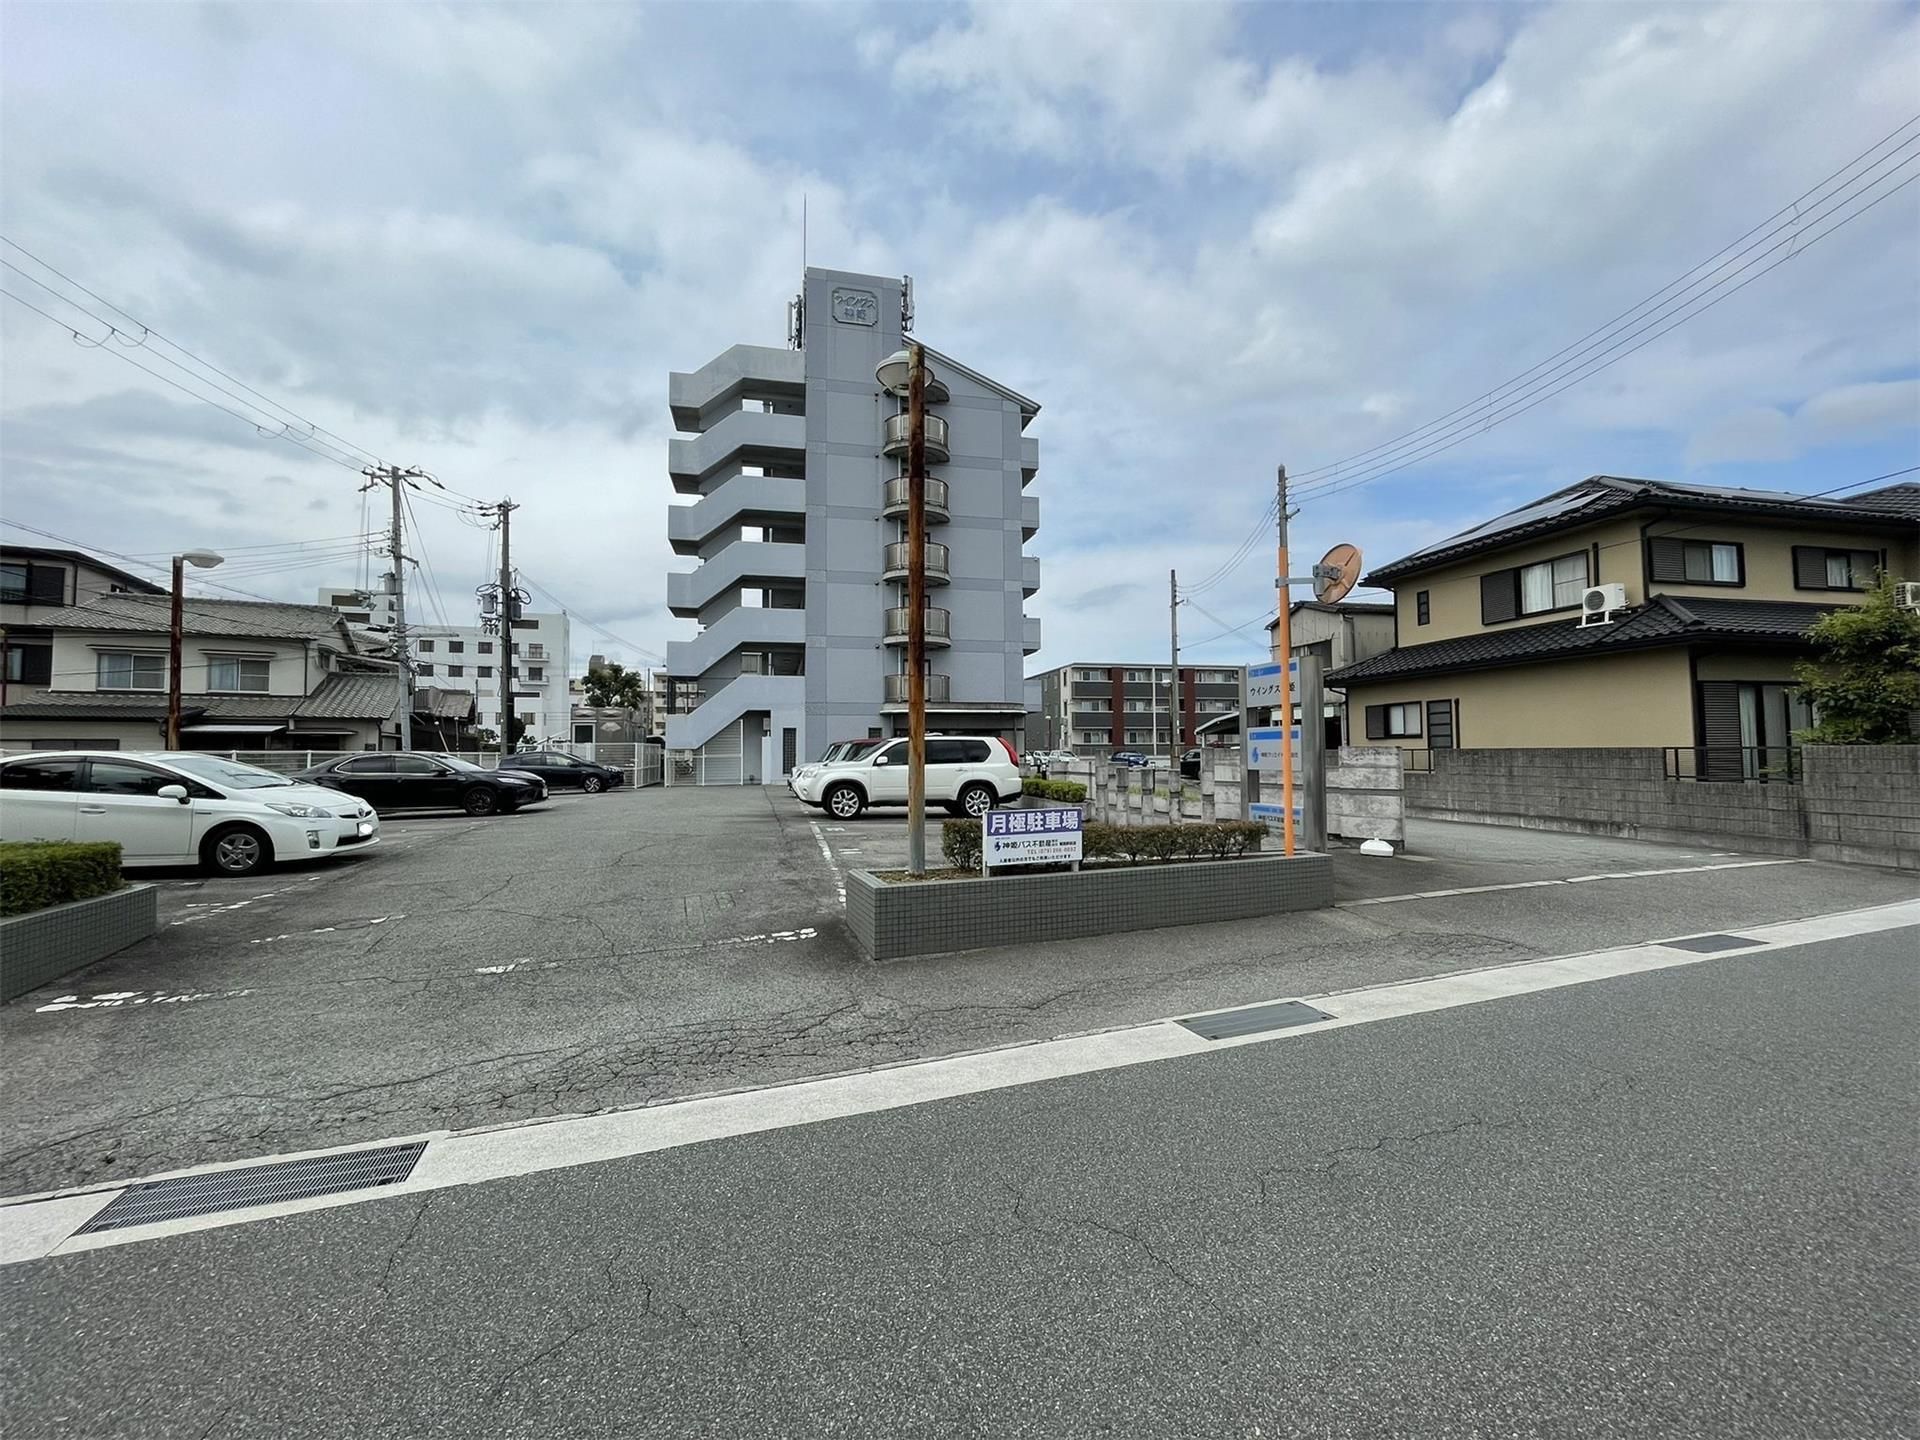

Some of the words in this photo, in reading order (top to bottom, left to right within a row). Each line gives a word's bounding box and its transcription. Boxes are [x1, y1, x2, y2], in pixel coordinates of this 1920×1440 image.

[1250, 681, 1297, 696] ウイングス姫
[991, 811, 1078, 833] 月極駐車場
